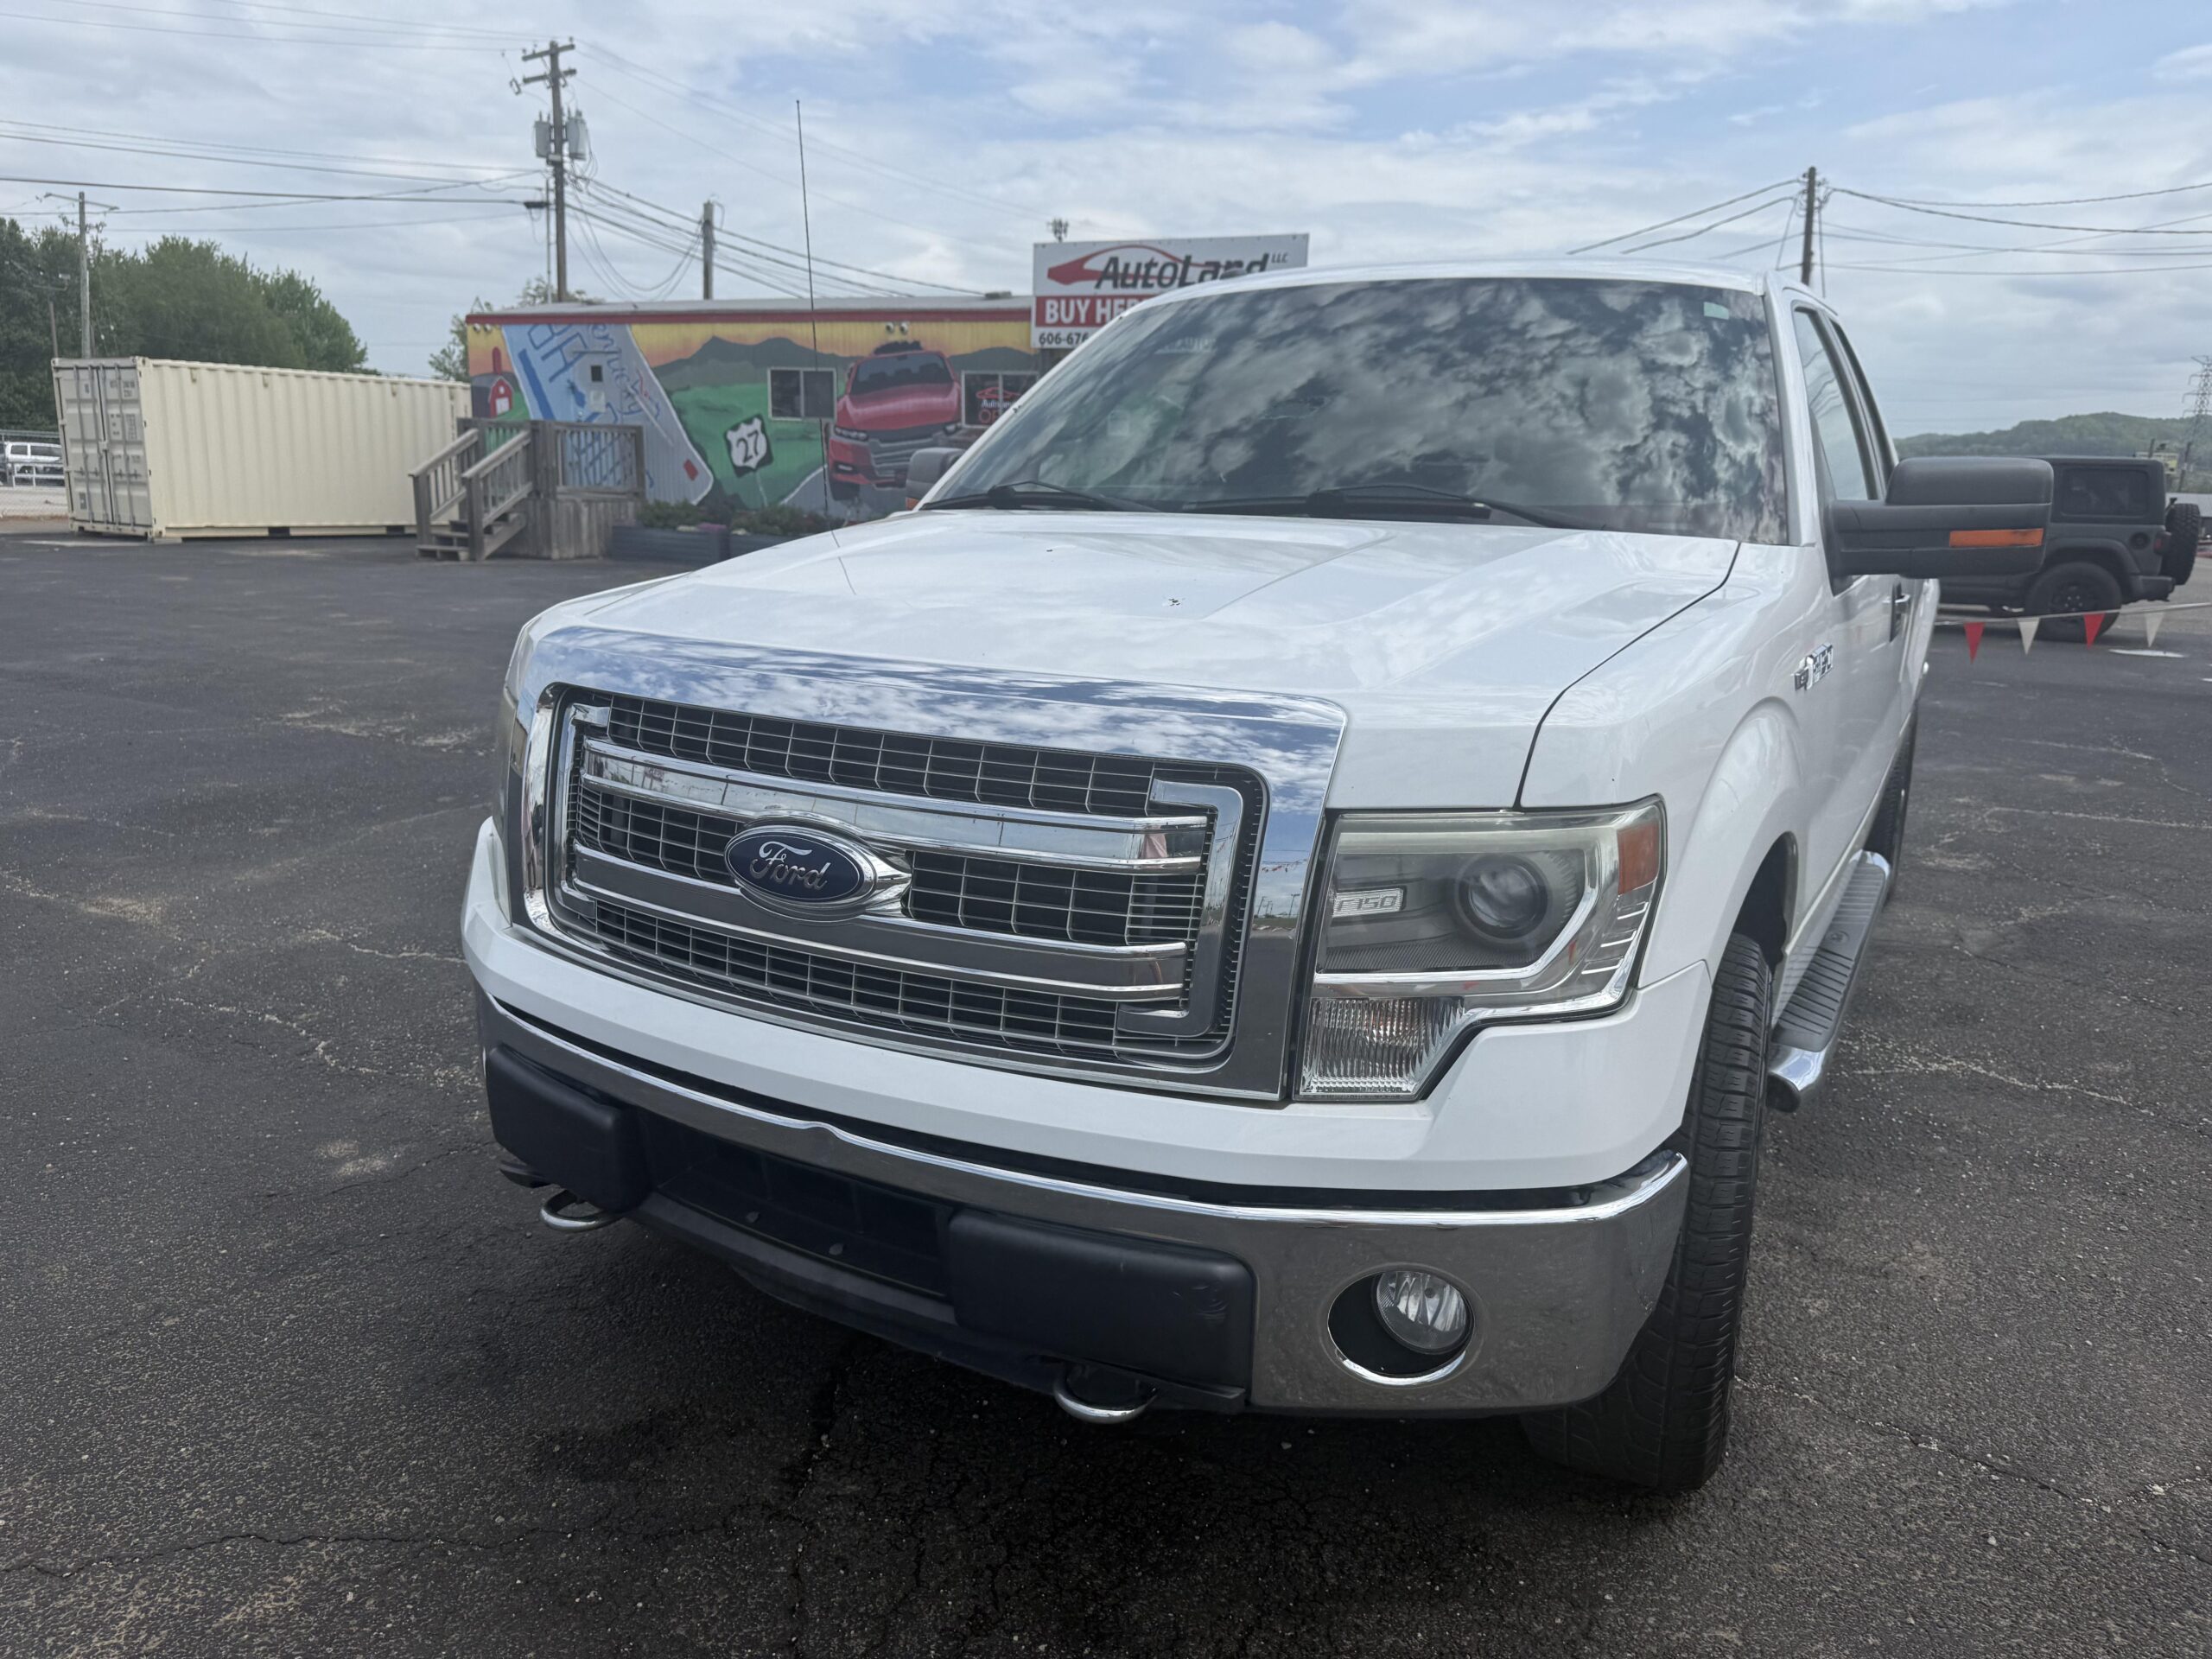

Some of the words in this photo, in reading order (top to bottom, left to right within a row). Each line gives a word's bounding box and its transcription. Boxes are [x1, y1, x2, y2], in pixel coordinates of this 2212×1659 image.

[1045, 298, 1090, 325] BUY
[1095, 298, 1141, 324] HE
[736, 429, 760, 463] 27
[749, 841, 831, 890] Ford
